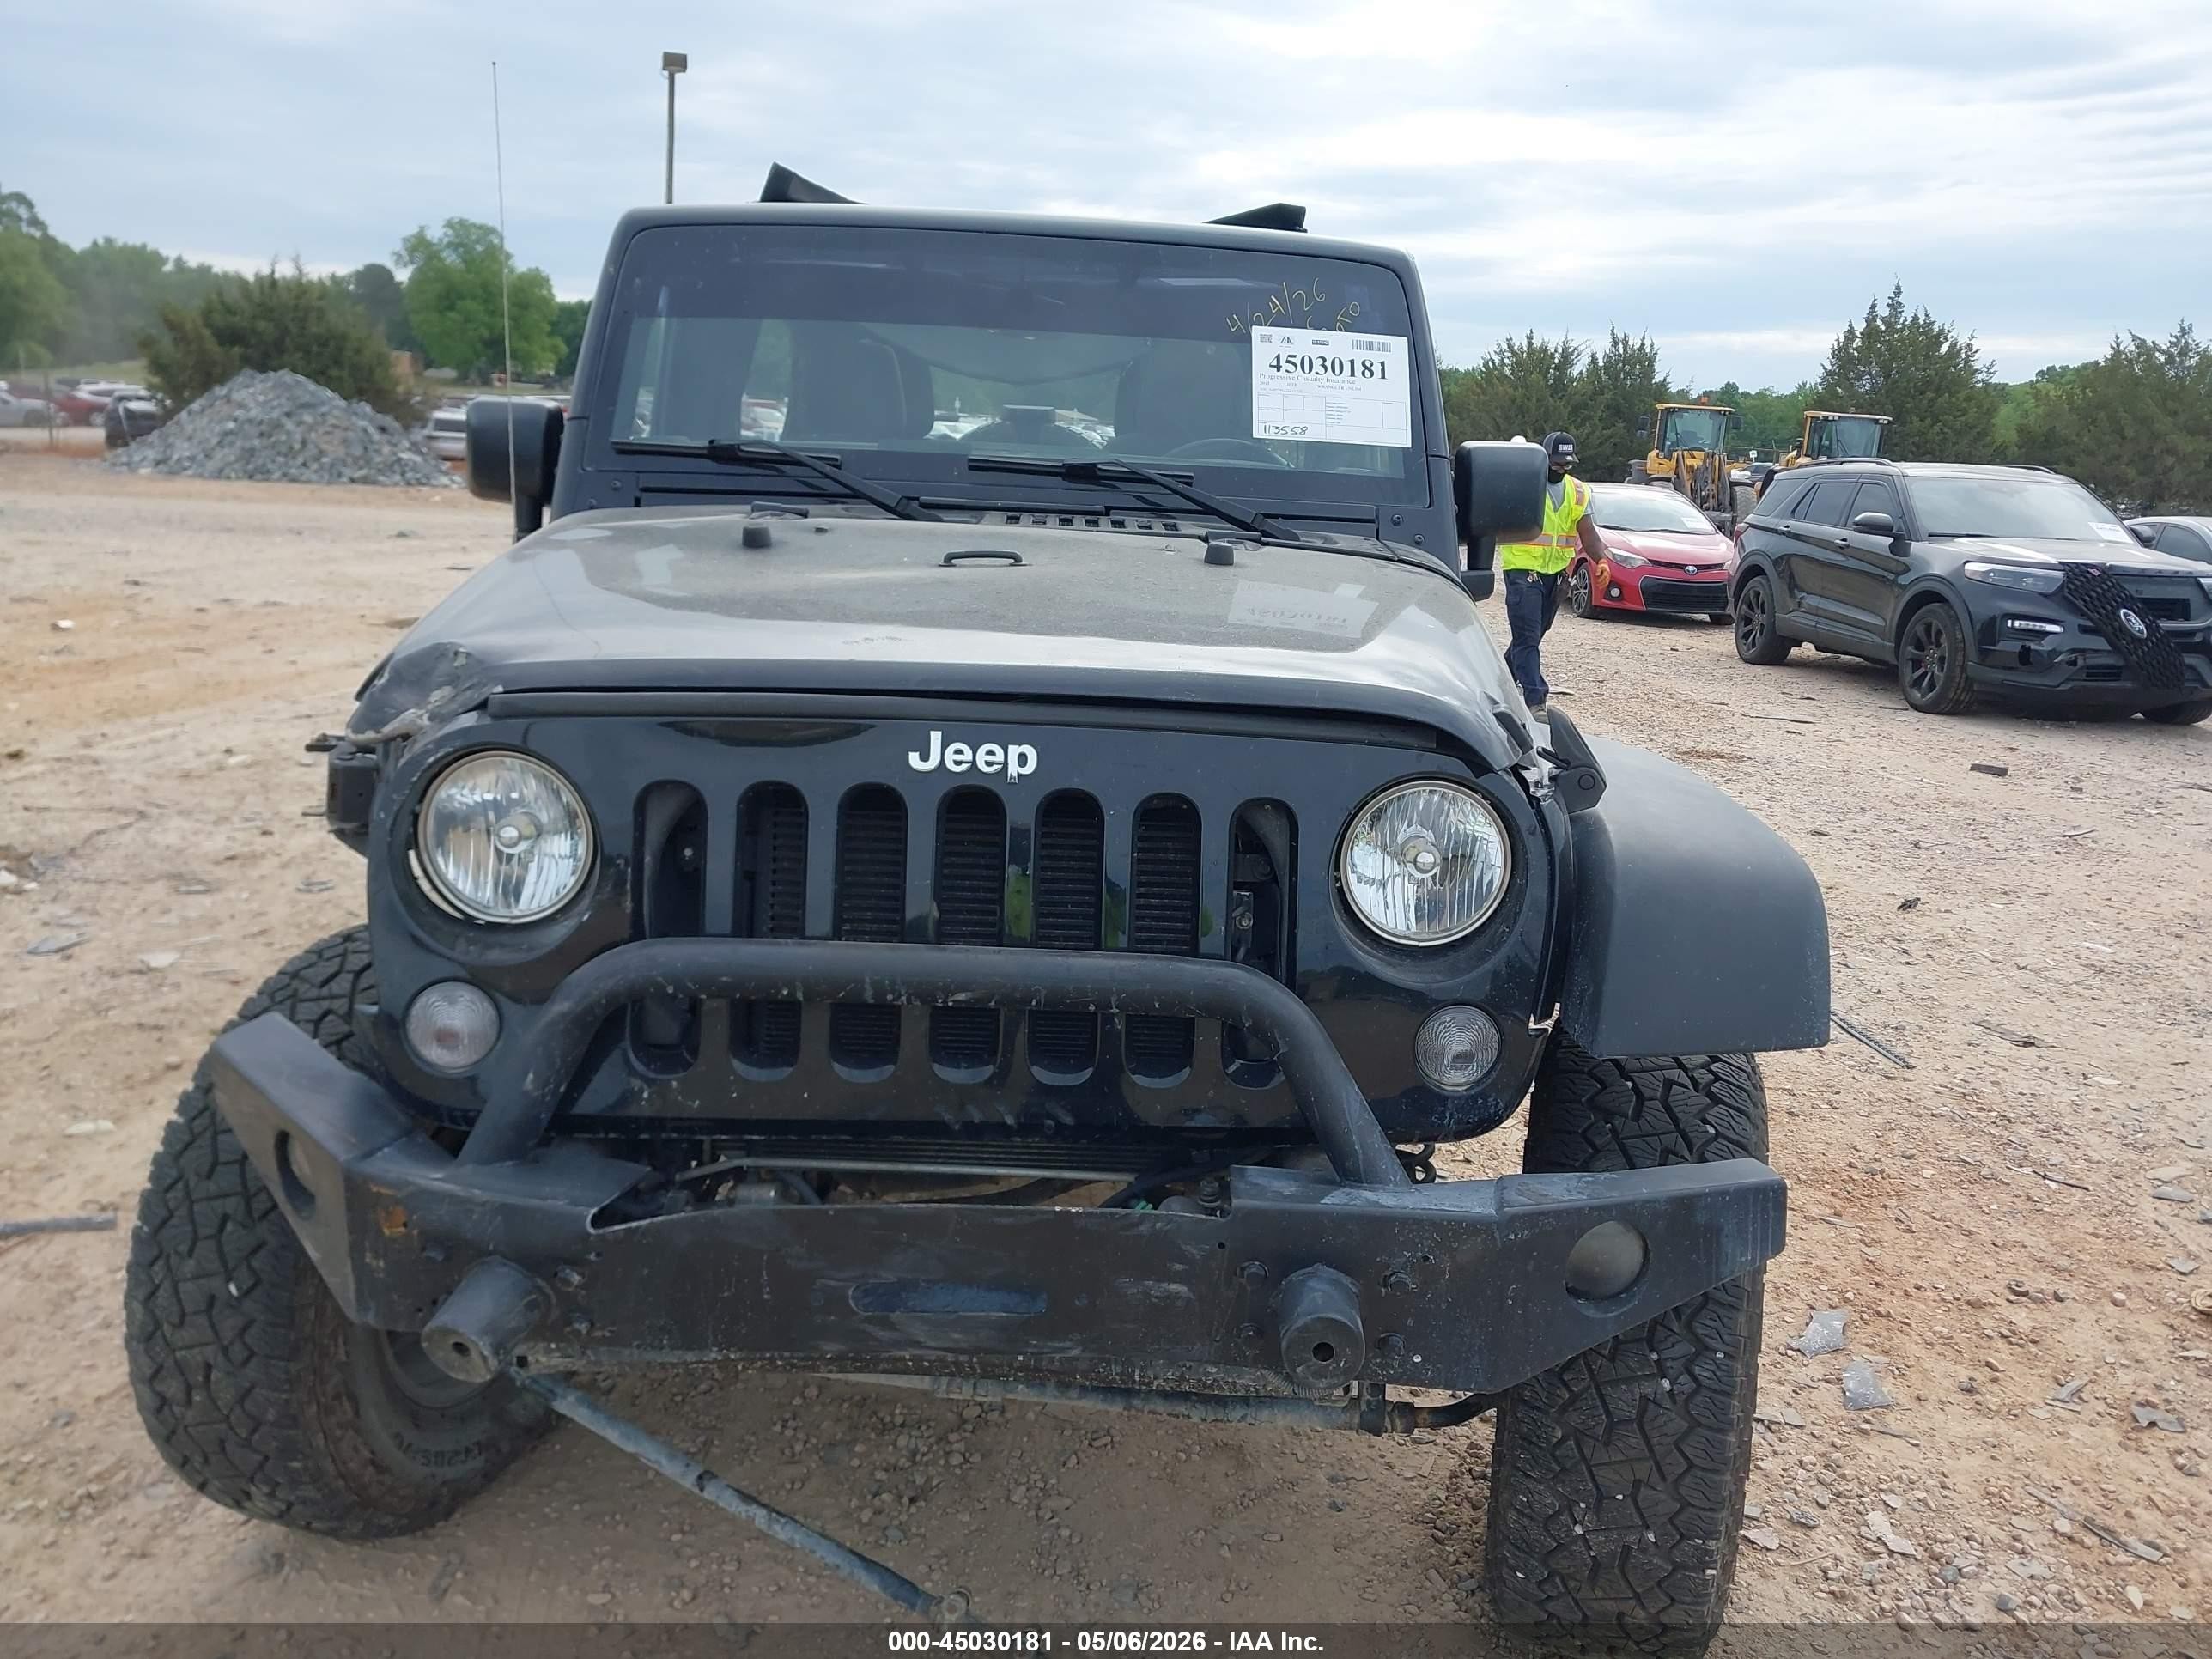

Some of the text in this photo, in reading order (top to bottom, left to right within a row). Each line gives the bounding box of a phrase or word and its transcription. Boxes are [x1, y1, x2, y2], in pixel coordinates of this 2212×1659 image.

[1226, 277, 1326, 334] 4/24/26
[1259, 372, 1357, 386] Progressive Casualty Insurance
[1268, 353, 1389, 380] 45030181
[1263, 424, 1309, 435] 113558
[908, 730, 1038, 783] Jeep
